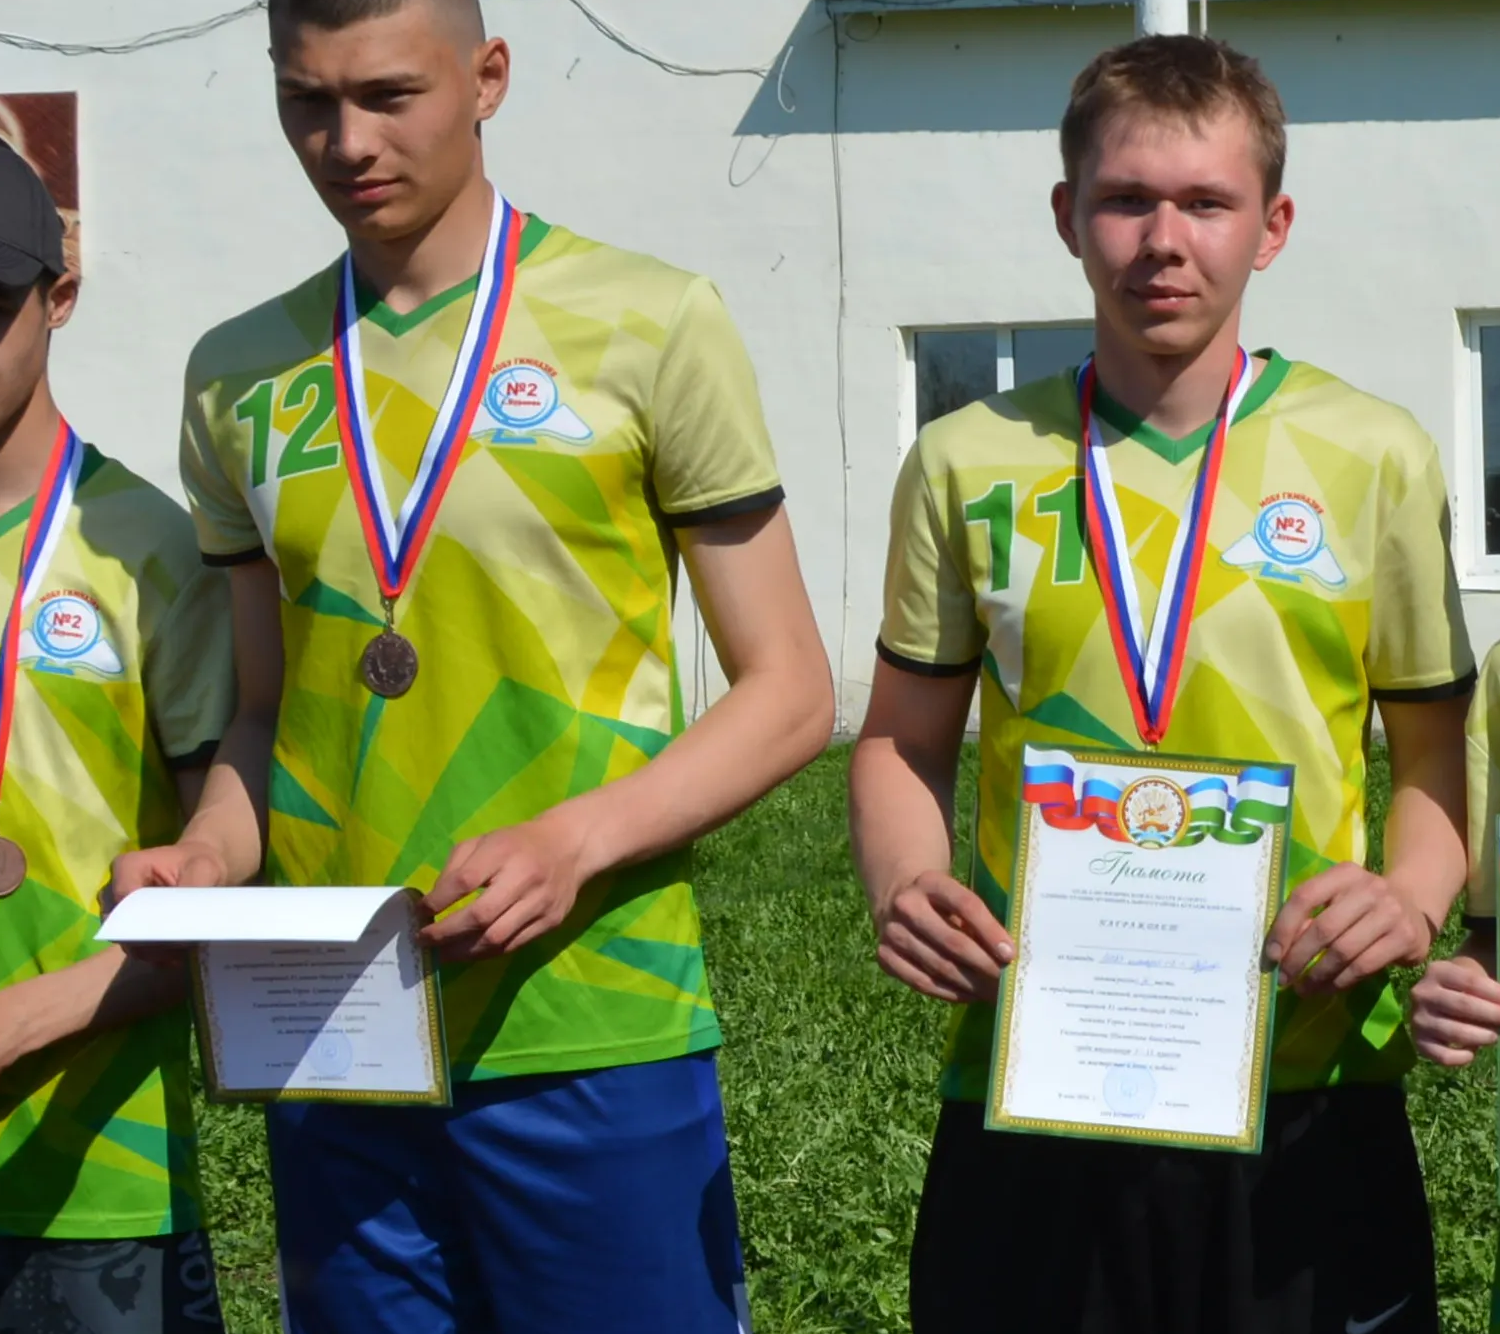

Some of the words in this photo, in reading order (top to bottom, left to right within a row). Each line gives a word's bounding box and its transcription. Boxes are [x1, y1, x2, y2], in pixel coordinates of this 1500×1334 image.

[506, 382, 538, 397] №2
[234, 362, 342, 489] 12
[963, 476, 1088, 593] 11
[1275, 517, 1306, 534] №2
[53, 612, 82, 629] №2
[1088, 851, 1207, 884] Грамота
